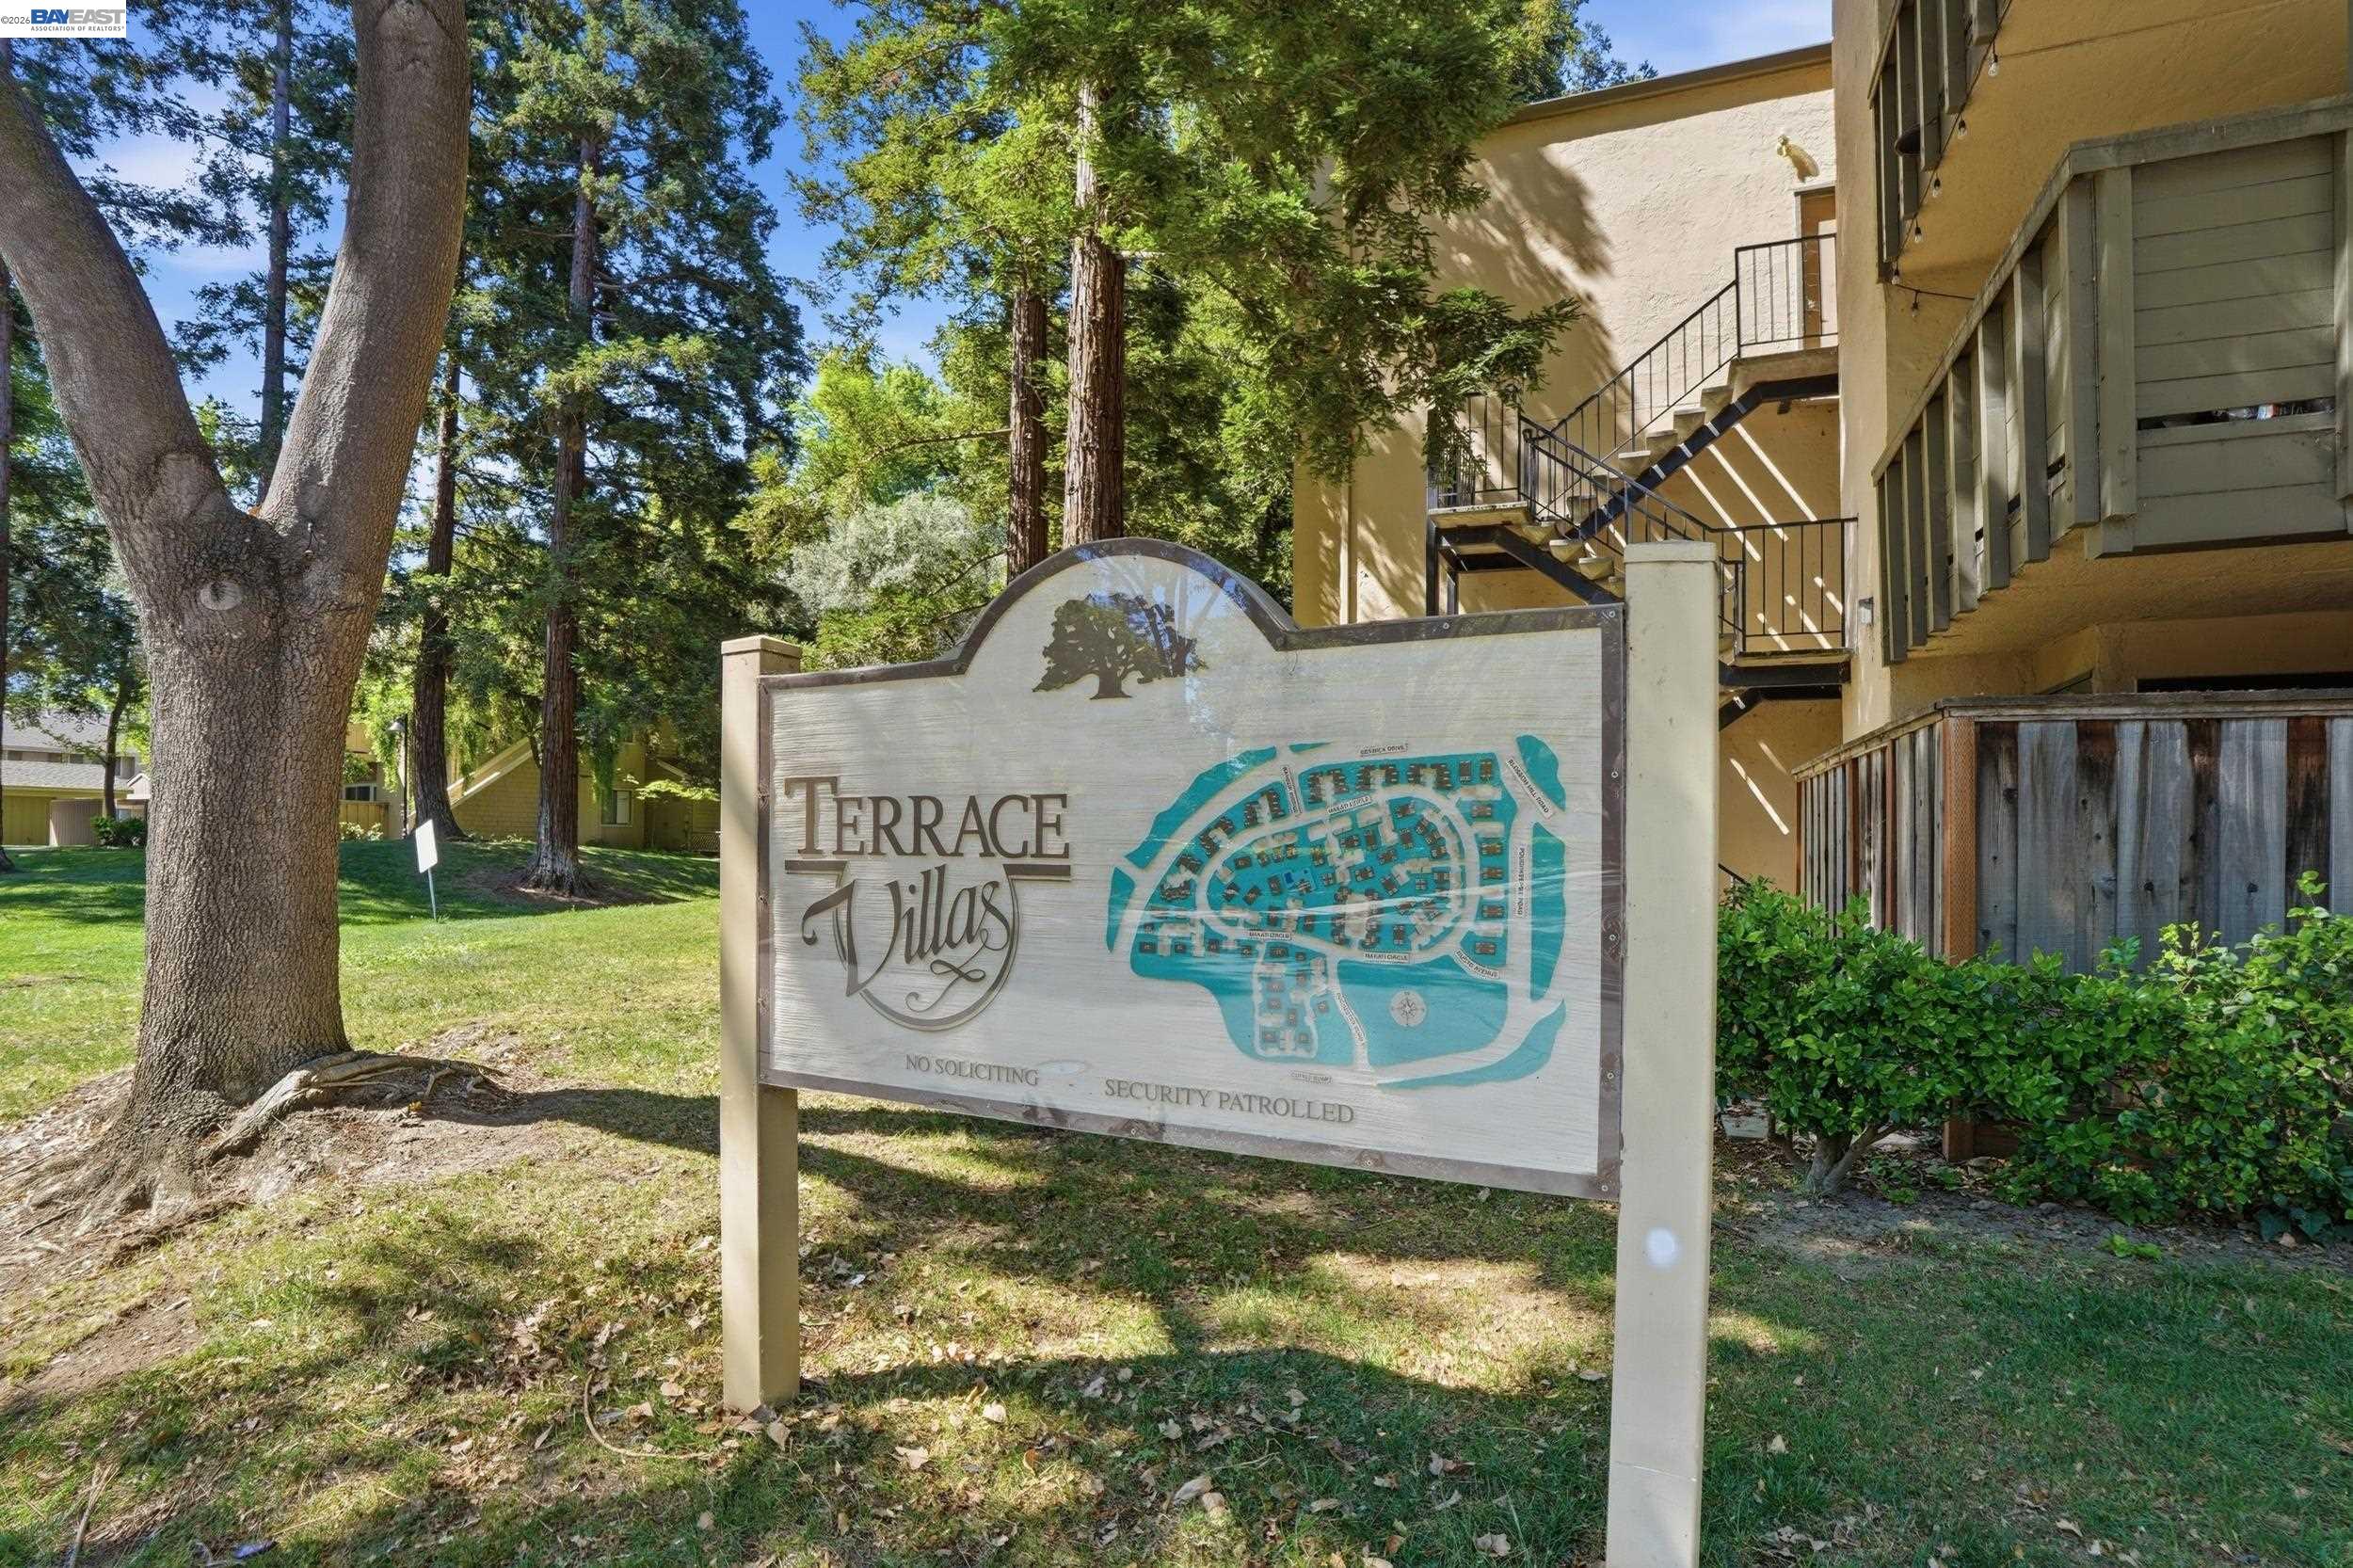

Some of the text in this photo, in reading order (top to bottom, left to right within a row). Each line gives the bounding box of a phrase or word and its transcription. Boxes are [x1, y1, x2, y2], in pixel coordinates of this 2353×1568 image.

[784, 776, 1070, 859] TERRACE
[802, 863, 1013, 1013] Villas
[905, 1054, 1040, 1086] NO SOLICITING
[1105, 1079, 1354, 1124] SECURITY PATROLLED
